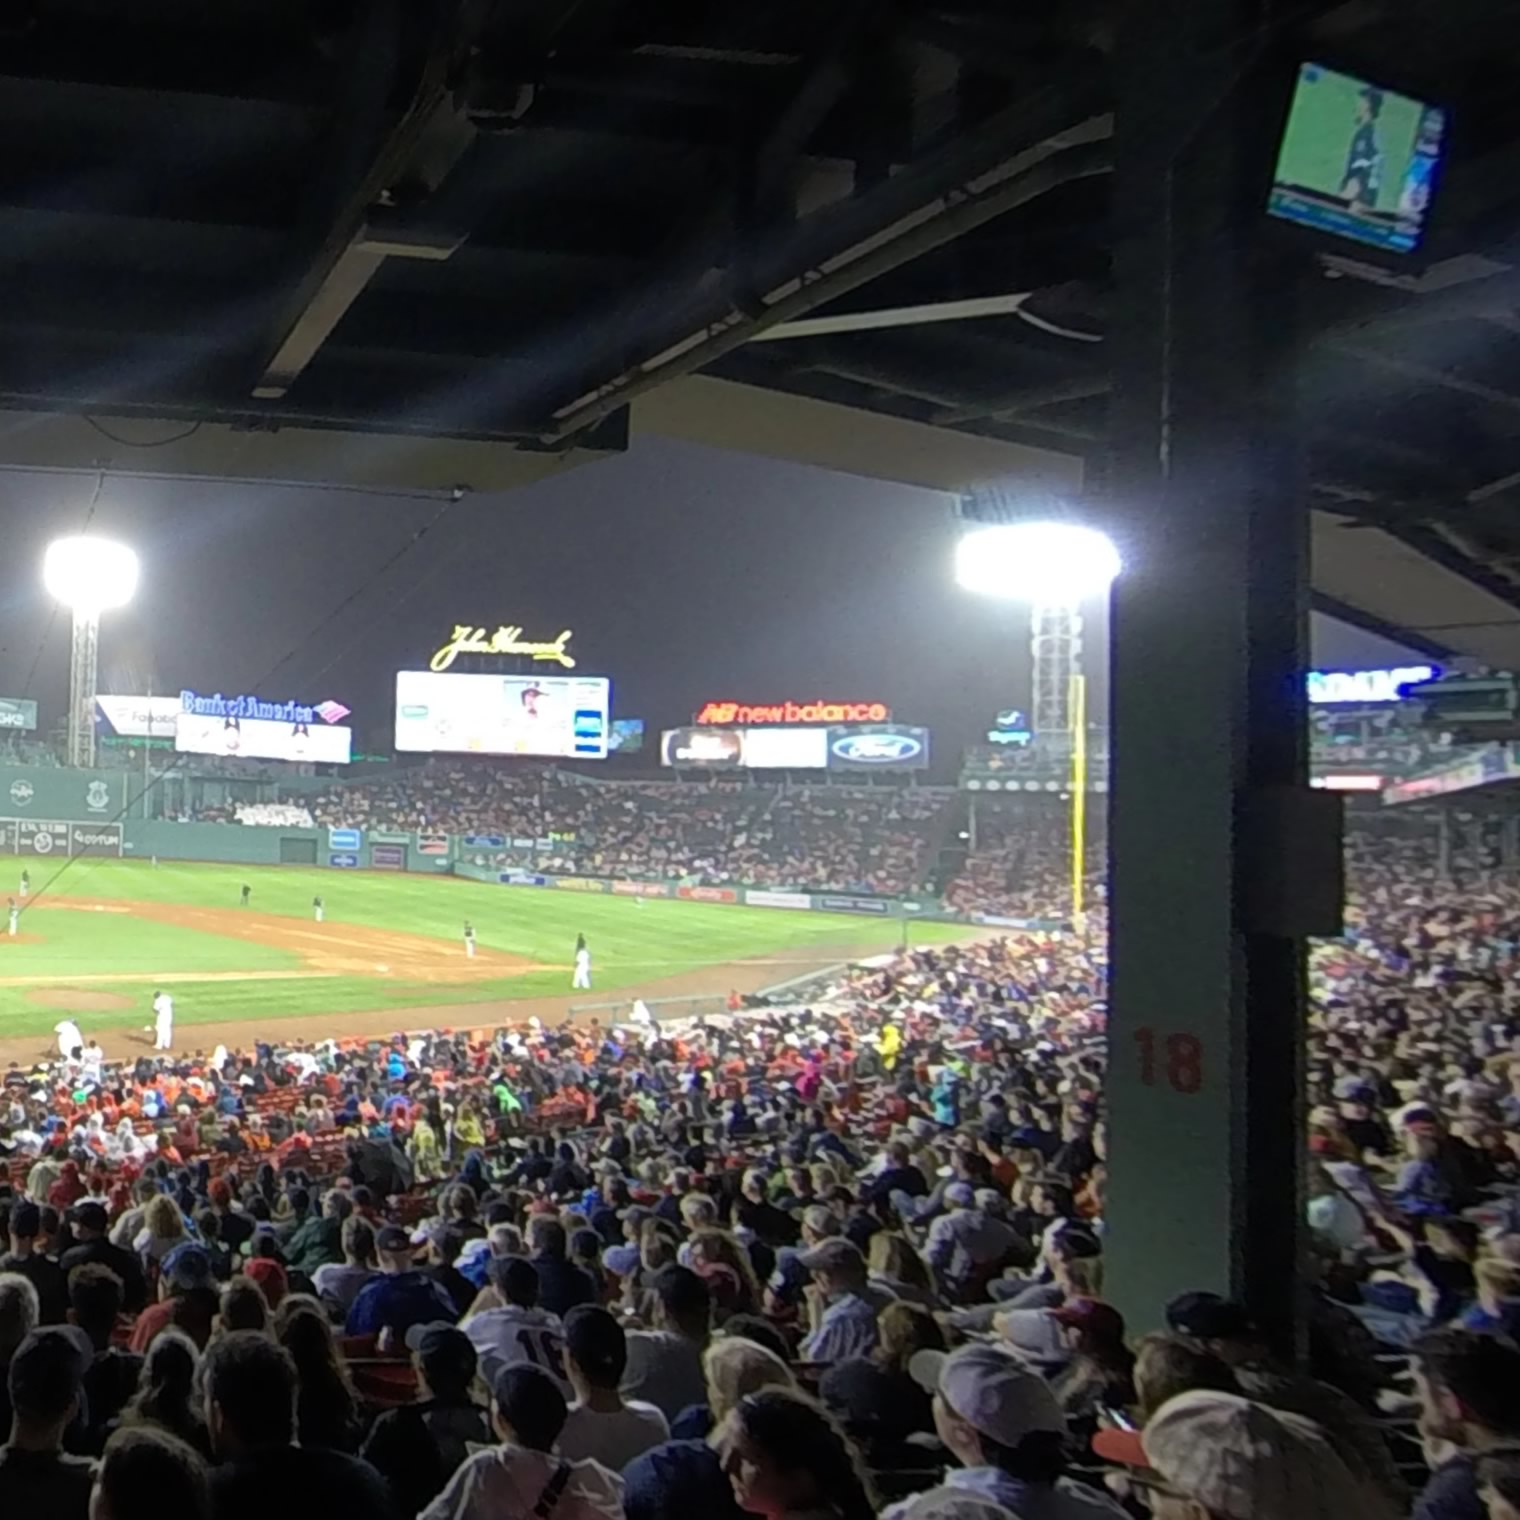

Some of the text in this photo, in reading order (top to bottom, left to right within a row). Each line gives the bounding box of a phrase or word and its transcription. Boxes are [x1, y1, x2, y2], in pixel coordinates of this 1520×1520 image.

[180, 690, 226, 714] Bank
[246, 696, 314, 723] America
[738, 707, 783, 722] new
[784, 700, 887, 722] balance
[1134, 1027, 1203, 1094] 18
